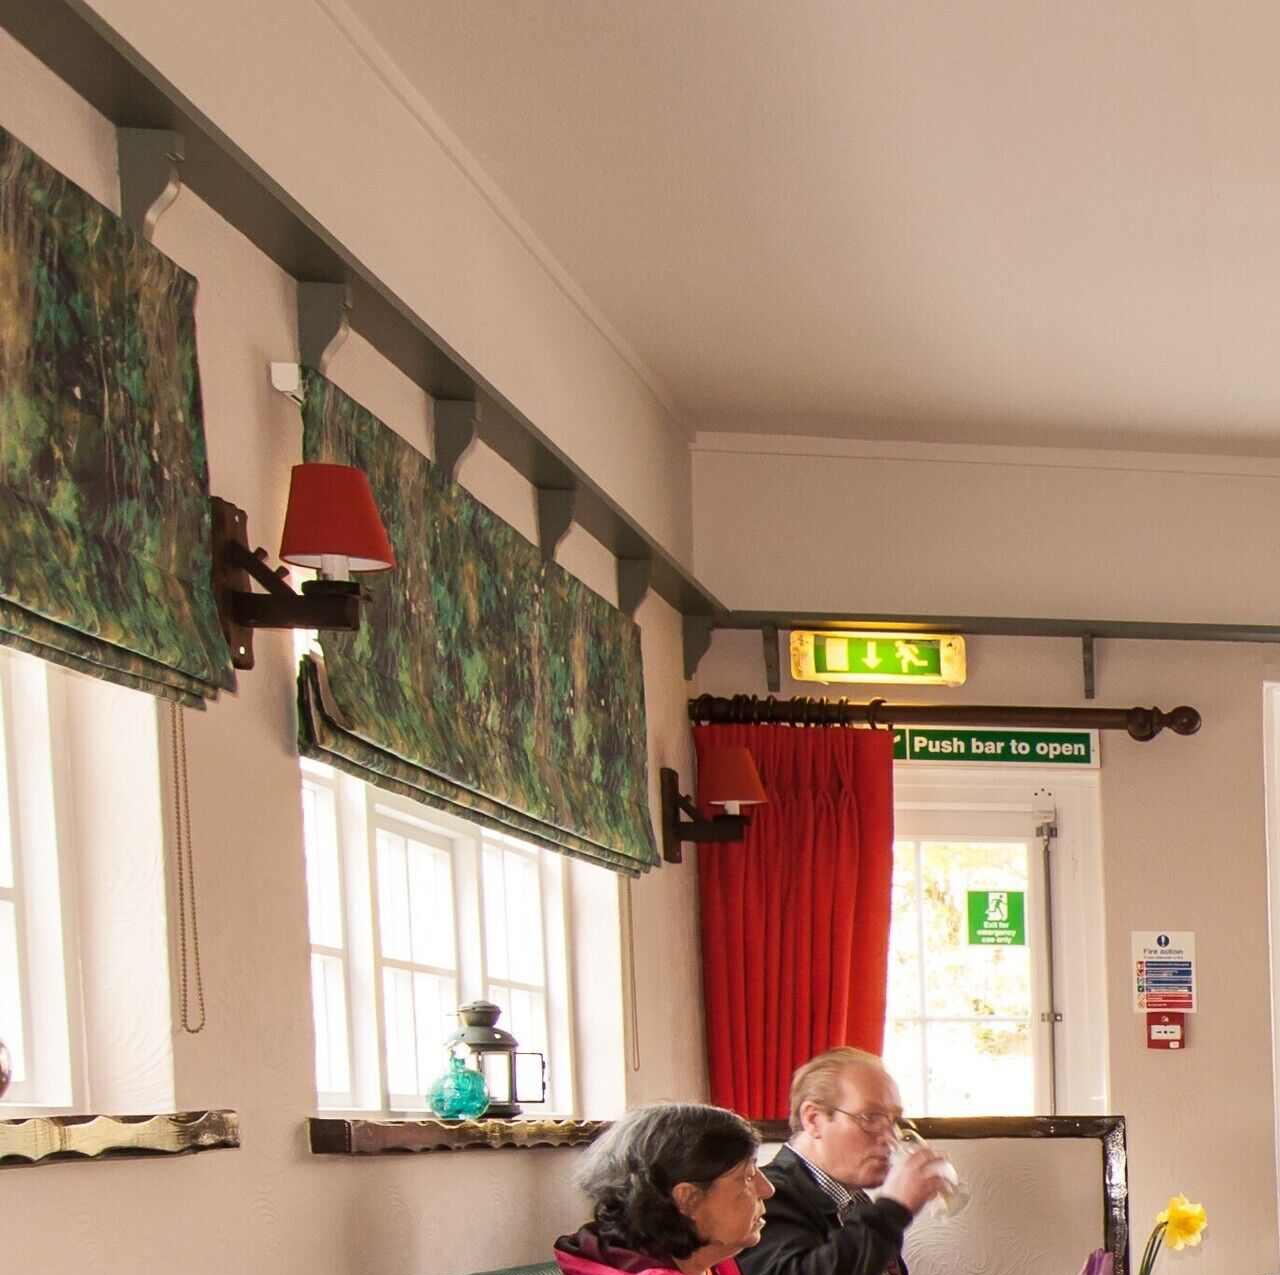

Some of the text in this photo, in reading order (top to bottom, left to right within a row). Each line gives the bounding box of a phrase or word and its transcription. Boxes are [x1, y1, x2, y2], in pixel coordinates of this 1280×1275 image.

[913, 736, 1086, 759] Push bar to open
[998, 921, 1010, 929] for
[976, 929, 1017, 938] emergency
[996, 937, 1013, 945] only
